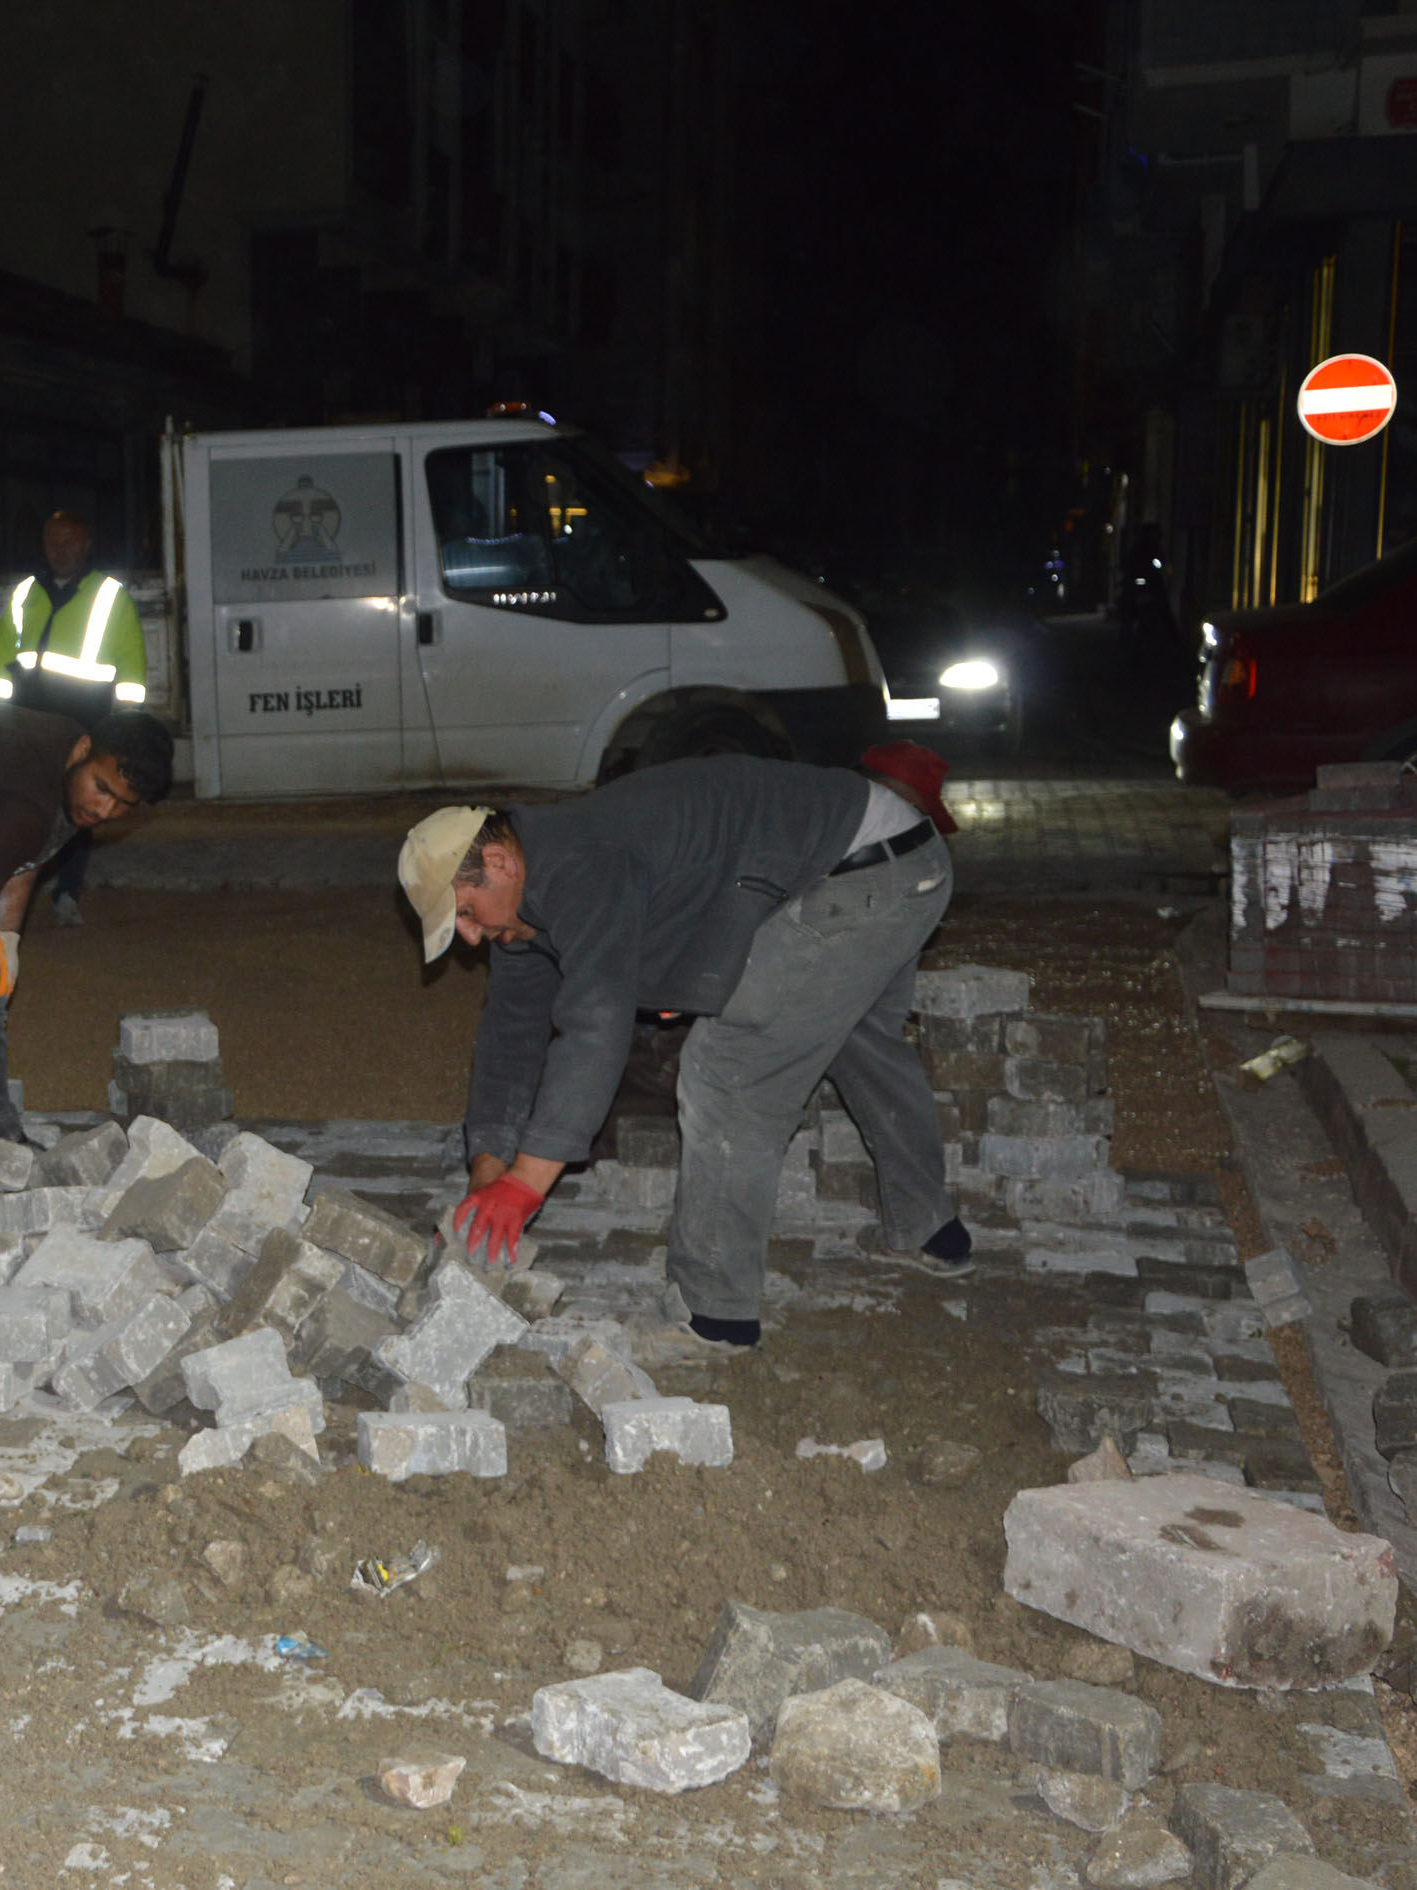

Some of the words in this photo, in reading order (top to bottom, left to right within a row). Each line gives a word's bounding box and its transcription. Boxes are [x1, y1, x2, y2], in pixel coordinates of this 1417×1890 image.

[240, 567, 289, 582] HAVZA
[293, 560, 376, 580] BELEDİYESİ
[249, 692, 289, 713] FEN
[296, 682, 362, 716] İŞLERİ
